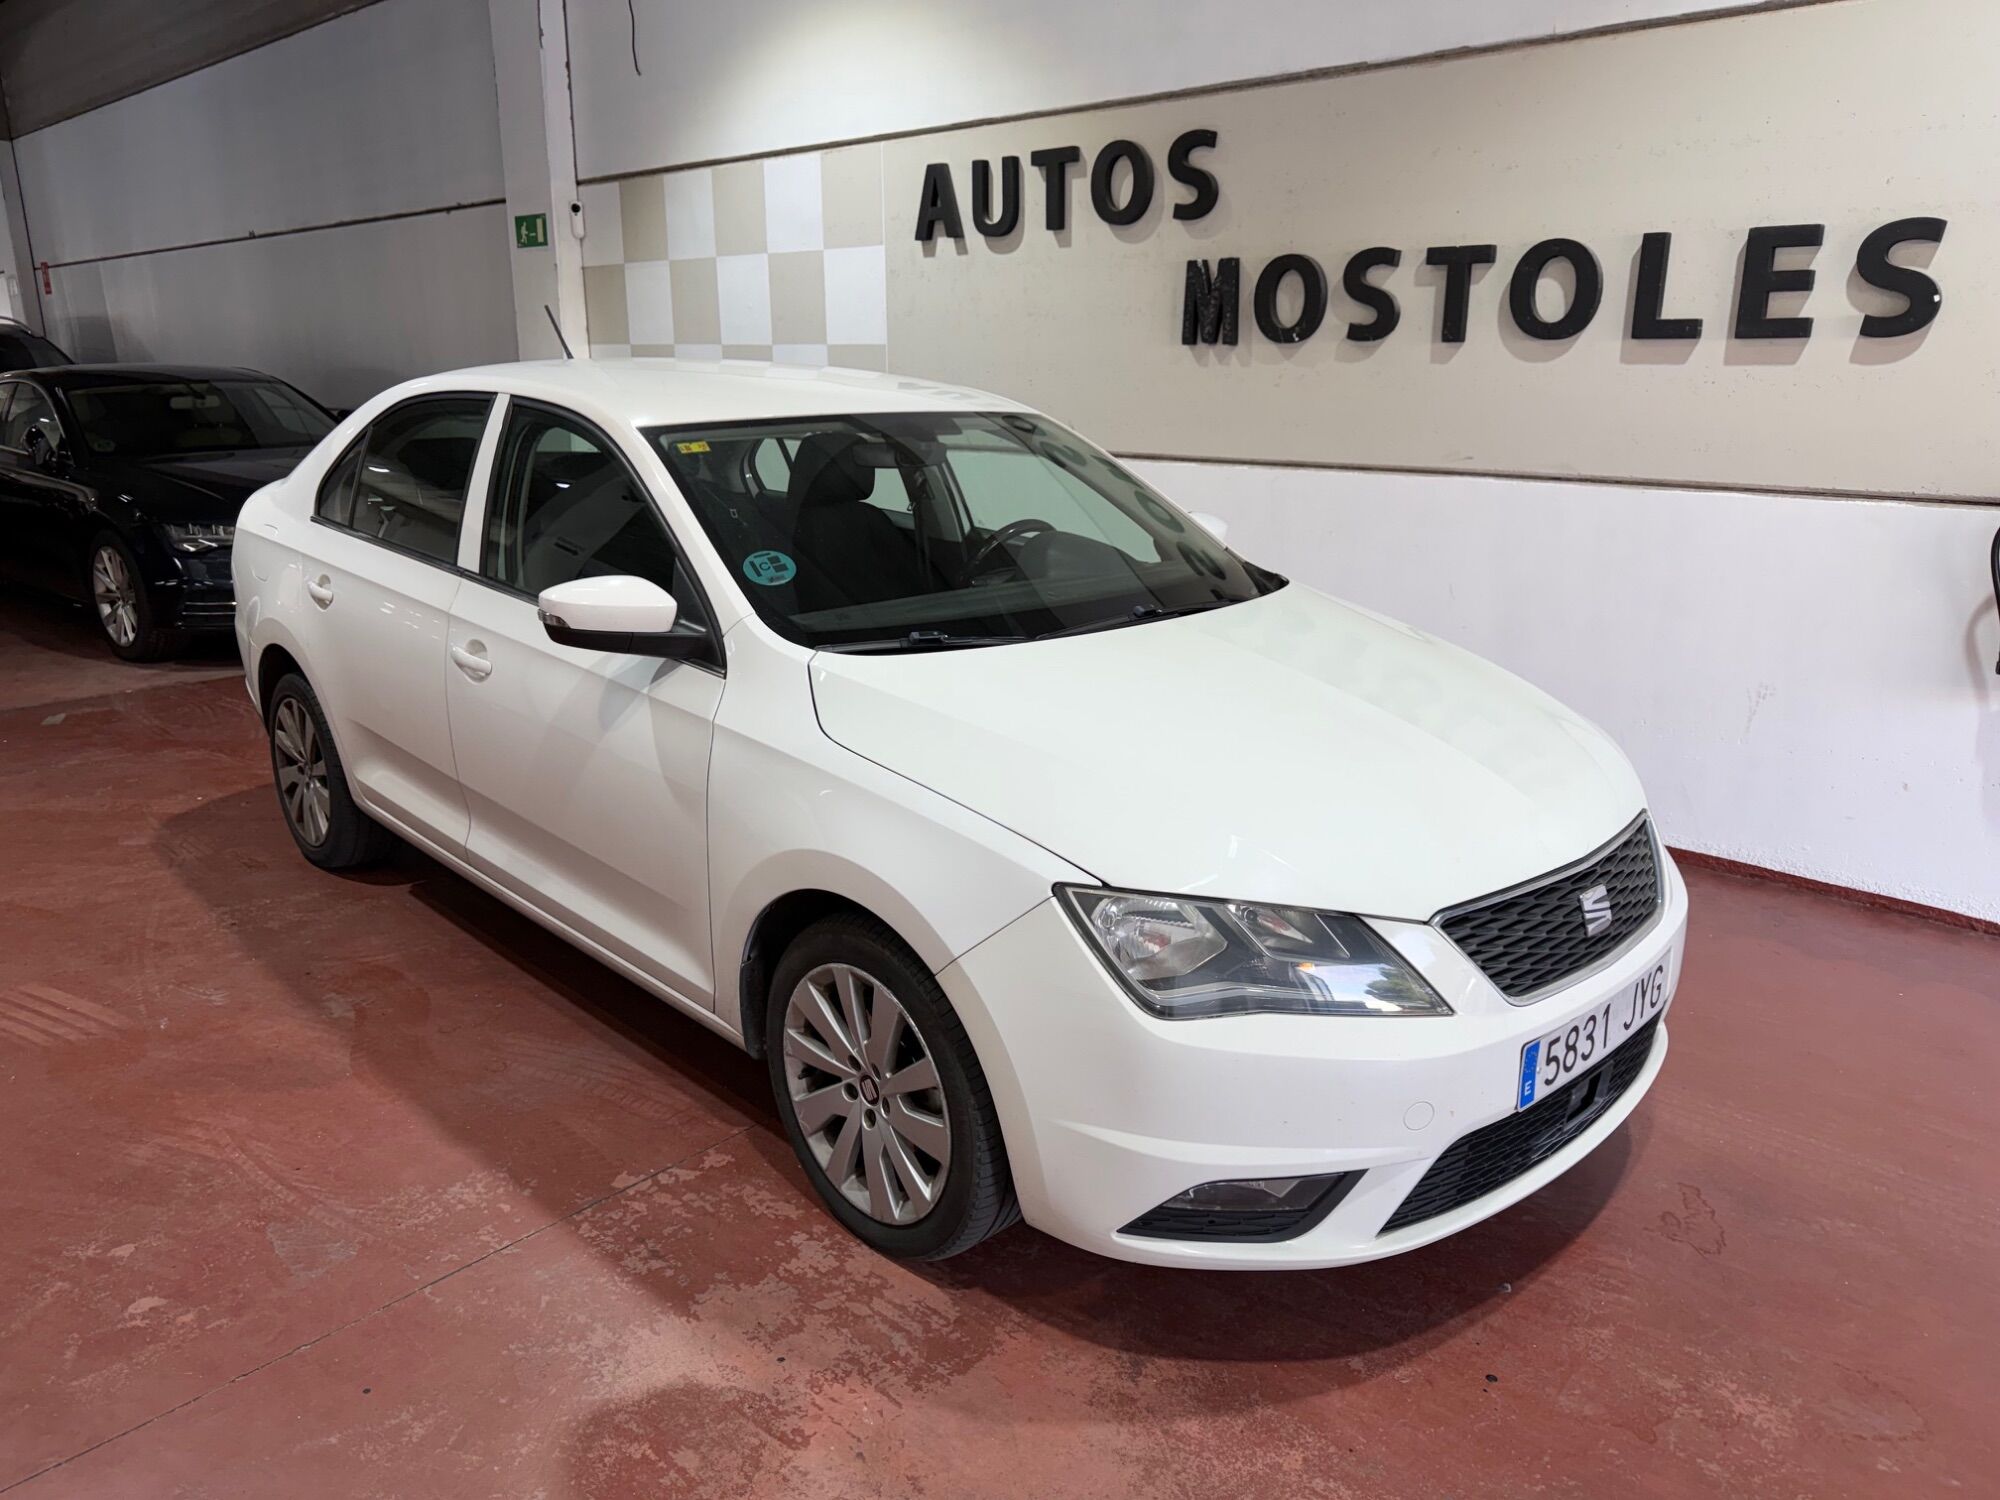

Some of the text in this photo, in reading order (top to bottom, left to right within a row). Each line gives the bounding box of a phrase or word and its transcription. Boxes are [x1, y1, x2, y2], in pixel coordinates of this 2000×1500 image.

[915, 128, 1220, 242] AUTOS
[1182, 217, 1947, 346] MOSTOLES
[1544, 964, 1664, 1087] 5831 JYG
[1524, 1080, 1533, 1096] E
